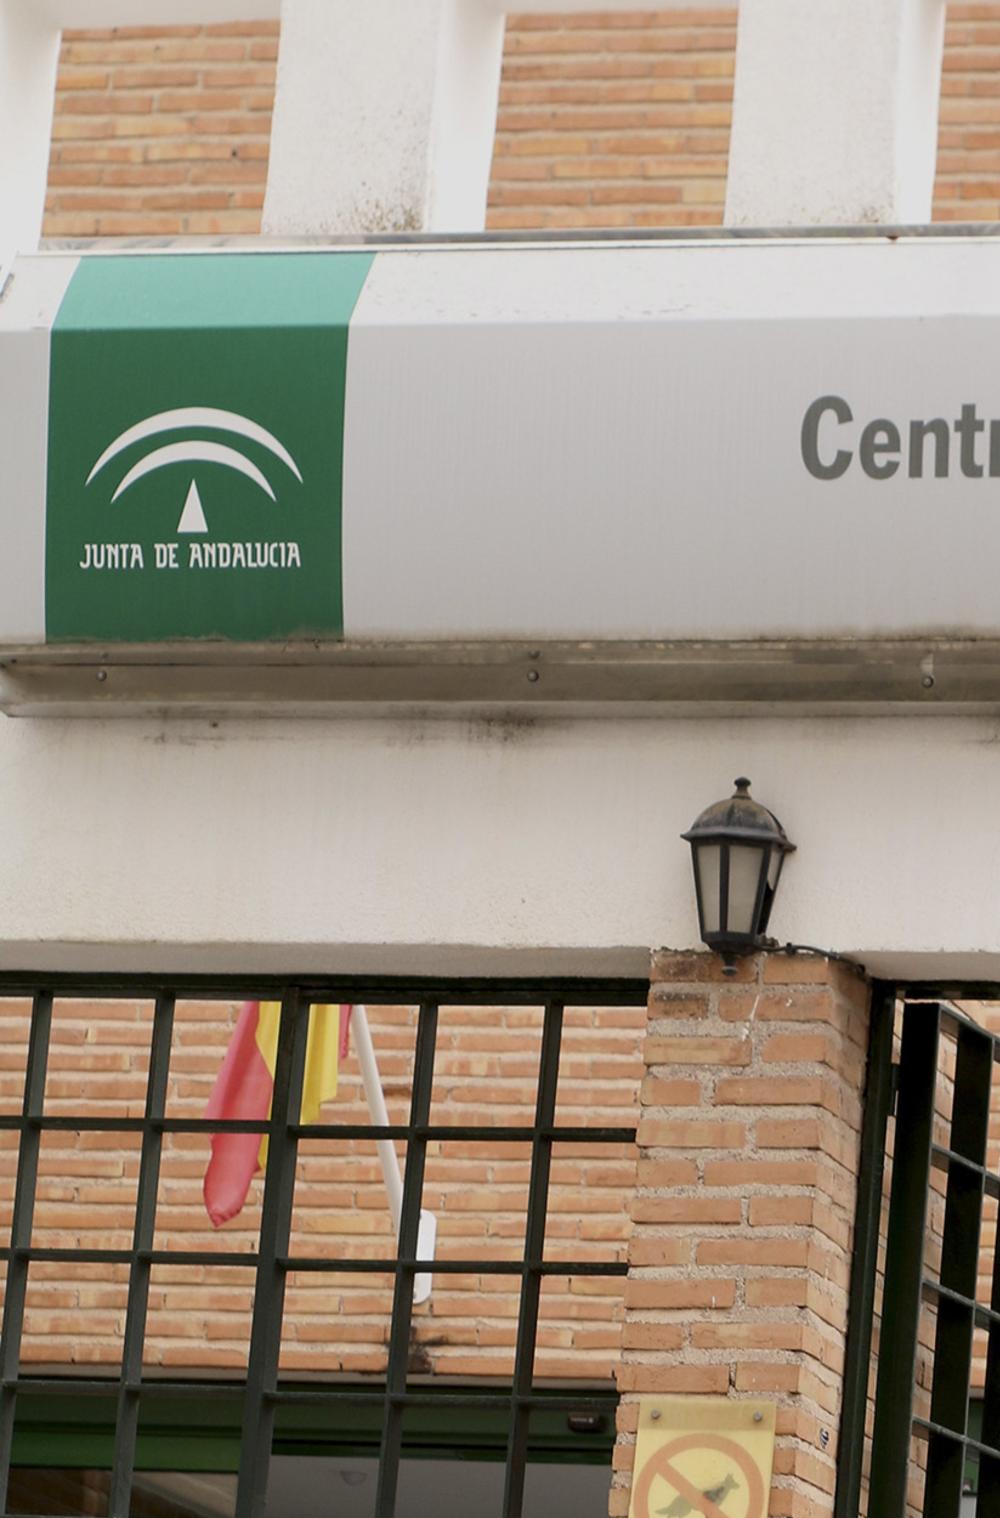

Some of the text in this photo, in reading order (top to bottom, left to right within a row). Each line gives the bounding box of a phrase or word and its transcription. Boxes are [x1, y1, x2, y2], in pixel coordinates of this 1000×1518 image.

[79, 542, 301, 569] JUNTA DE ANDALUCIA
